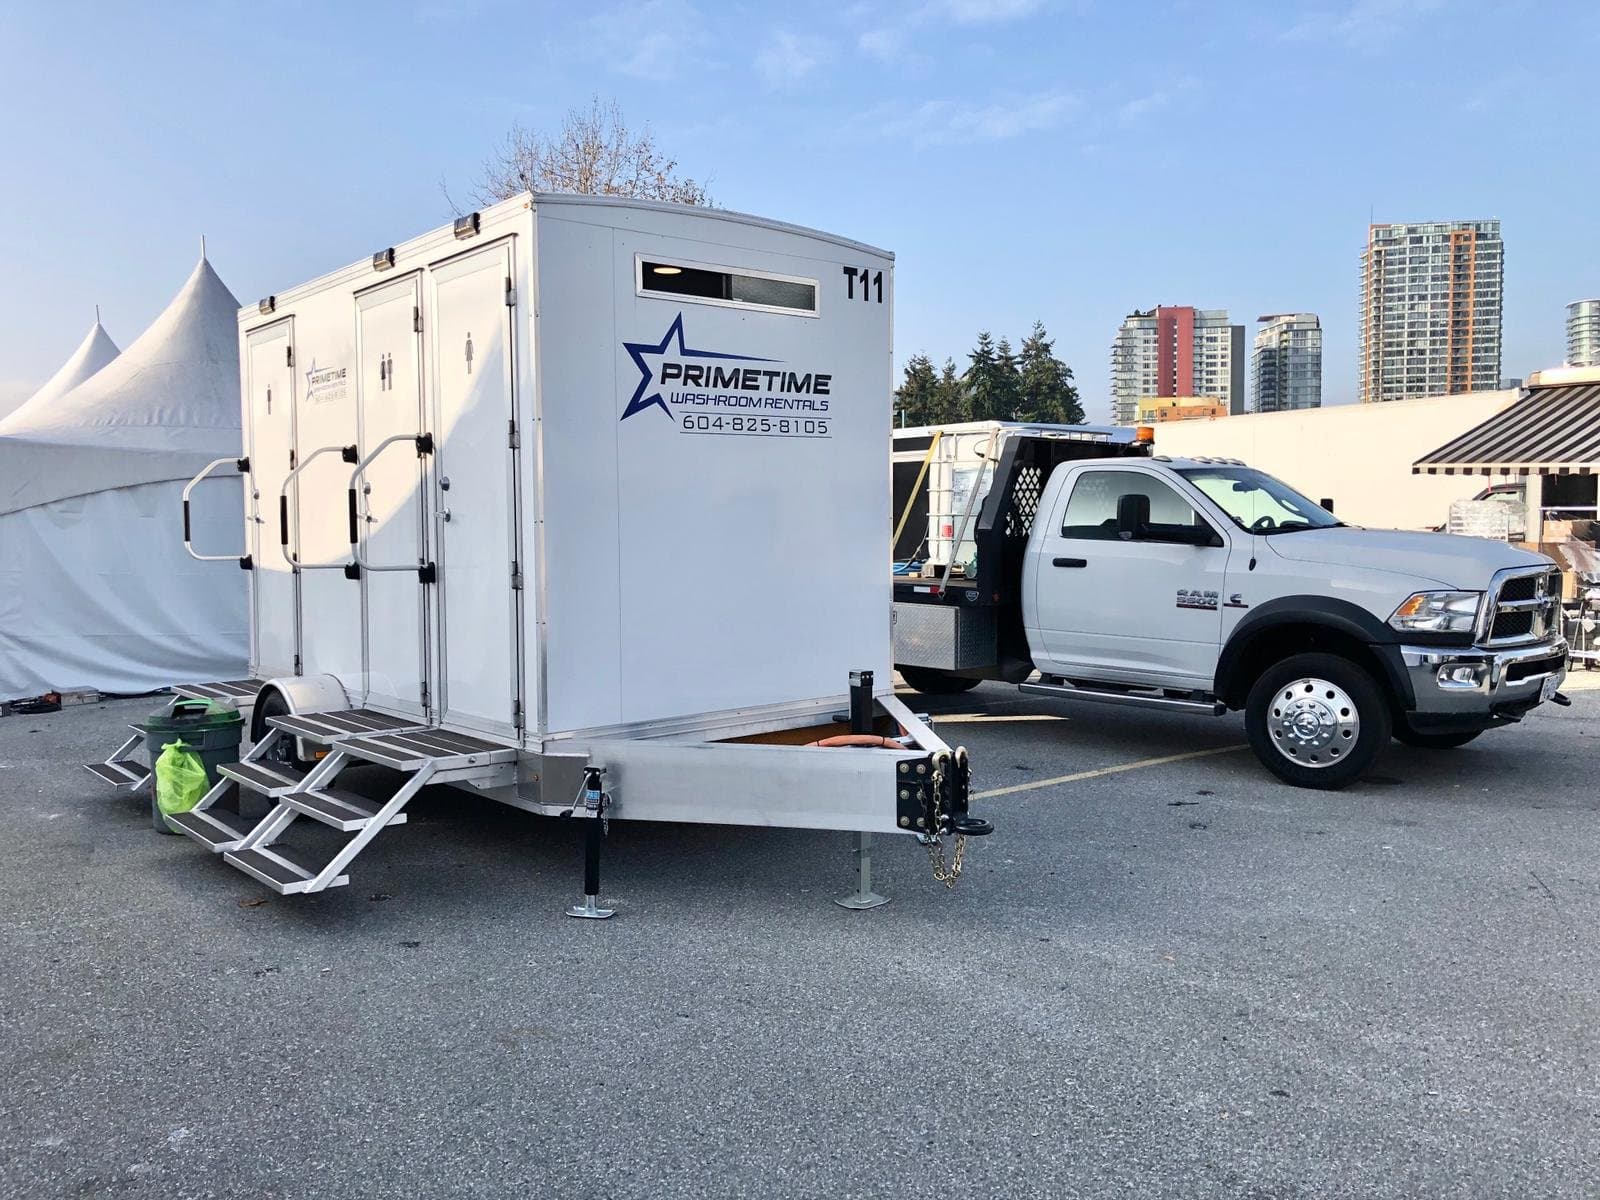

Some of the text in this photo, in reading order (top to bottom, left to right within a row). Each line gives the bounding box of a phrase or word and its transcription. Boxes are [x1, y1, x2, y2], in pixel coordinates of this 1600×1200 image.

[843, 266, 883, 303] T11
[660, 362, 832, 395] PRIMETIME
[670, 391, 829, 411] WASHROOM RENTALS
[683, 415, 828, 434] 604-825-8105
[1177, 589, 1218, 598] RAM
